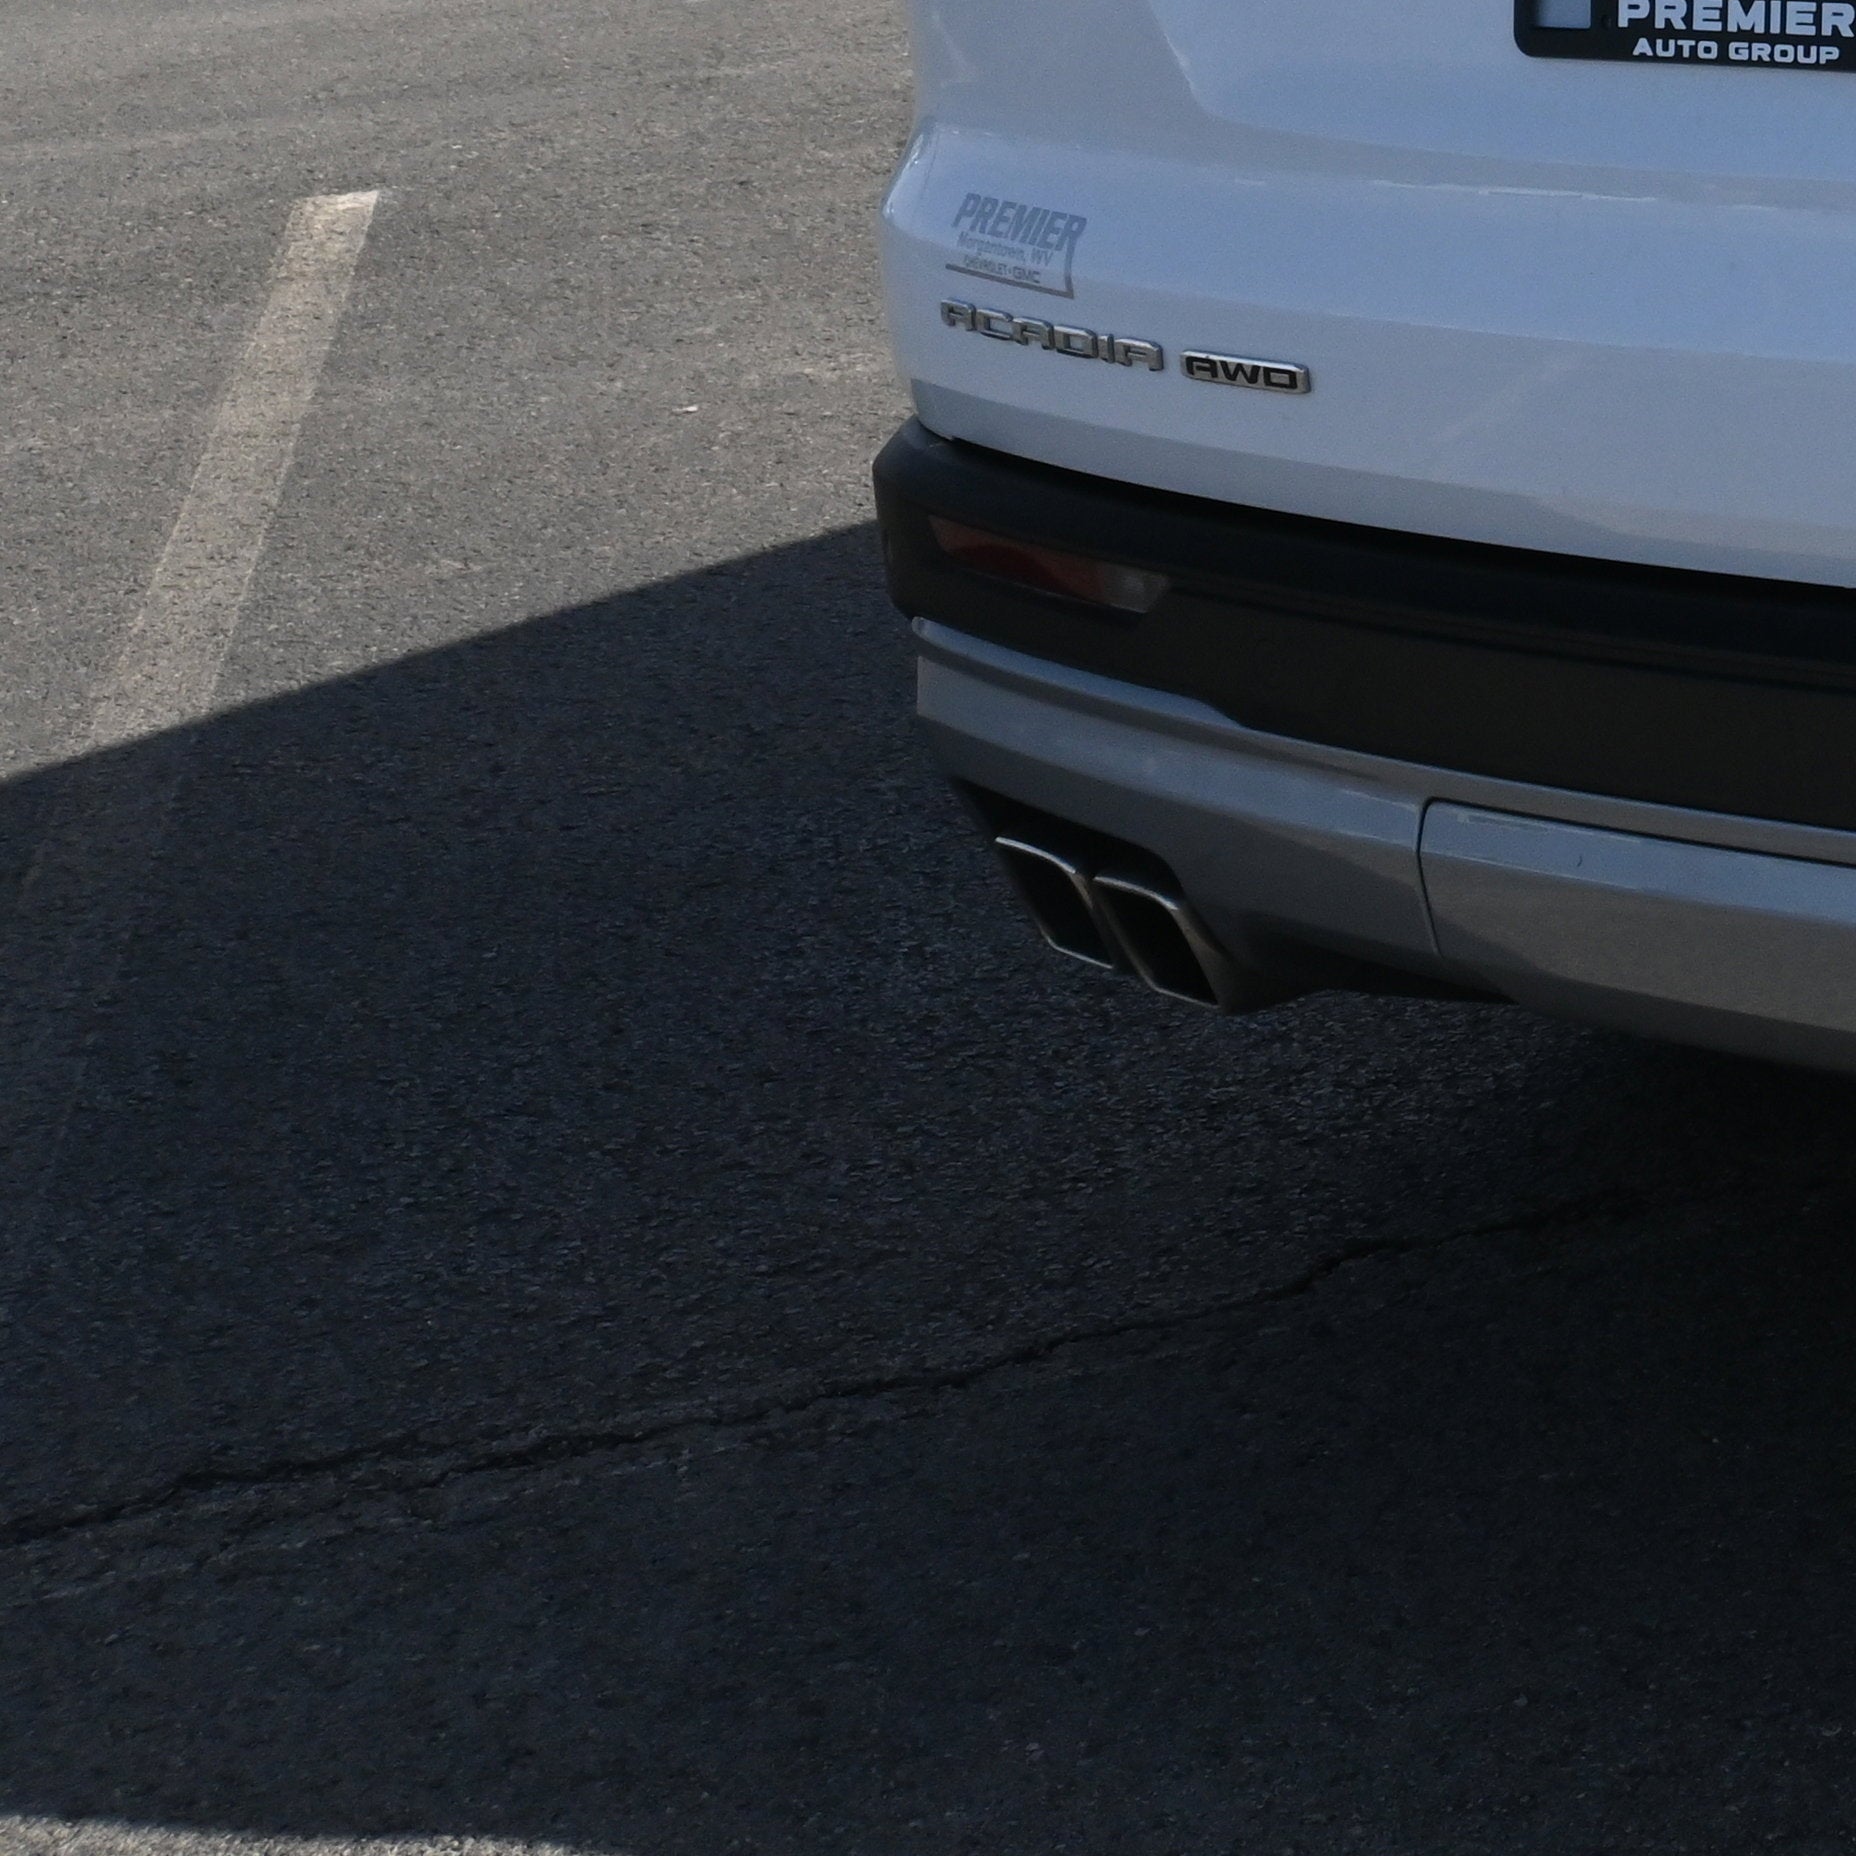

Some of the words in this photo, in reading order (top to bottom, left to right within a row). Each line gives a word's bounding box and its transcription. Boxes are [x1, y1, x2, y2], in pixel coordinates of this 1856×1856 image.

[1632, 37, 1719, 61] AUTO
[1727, 42, 1841, 66] GROUP
[951, 192, 1088, 253] PREMIER
[939, 297, 1165, 372] ACADIA
[1184, 354, 1299, 391] AWD
